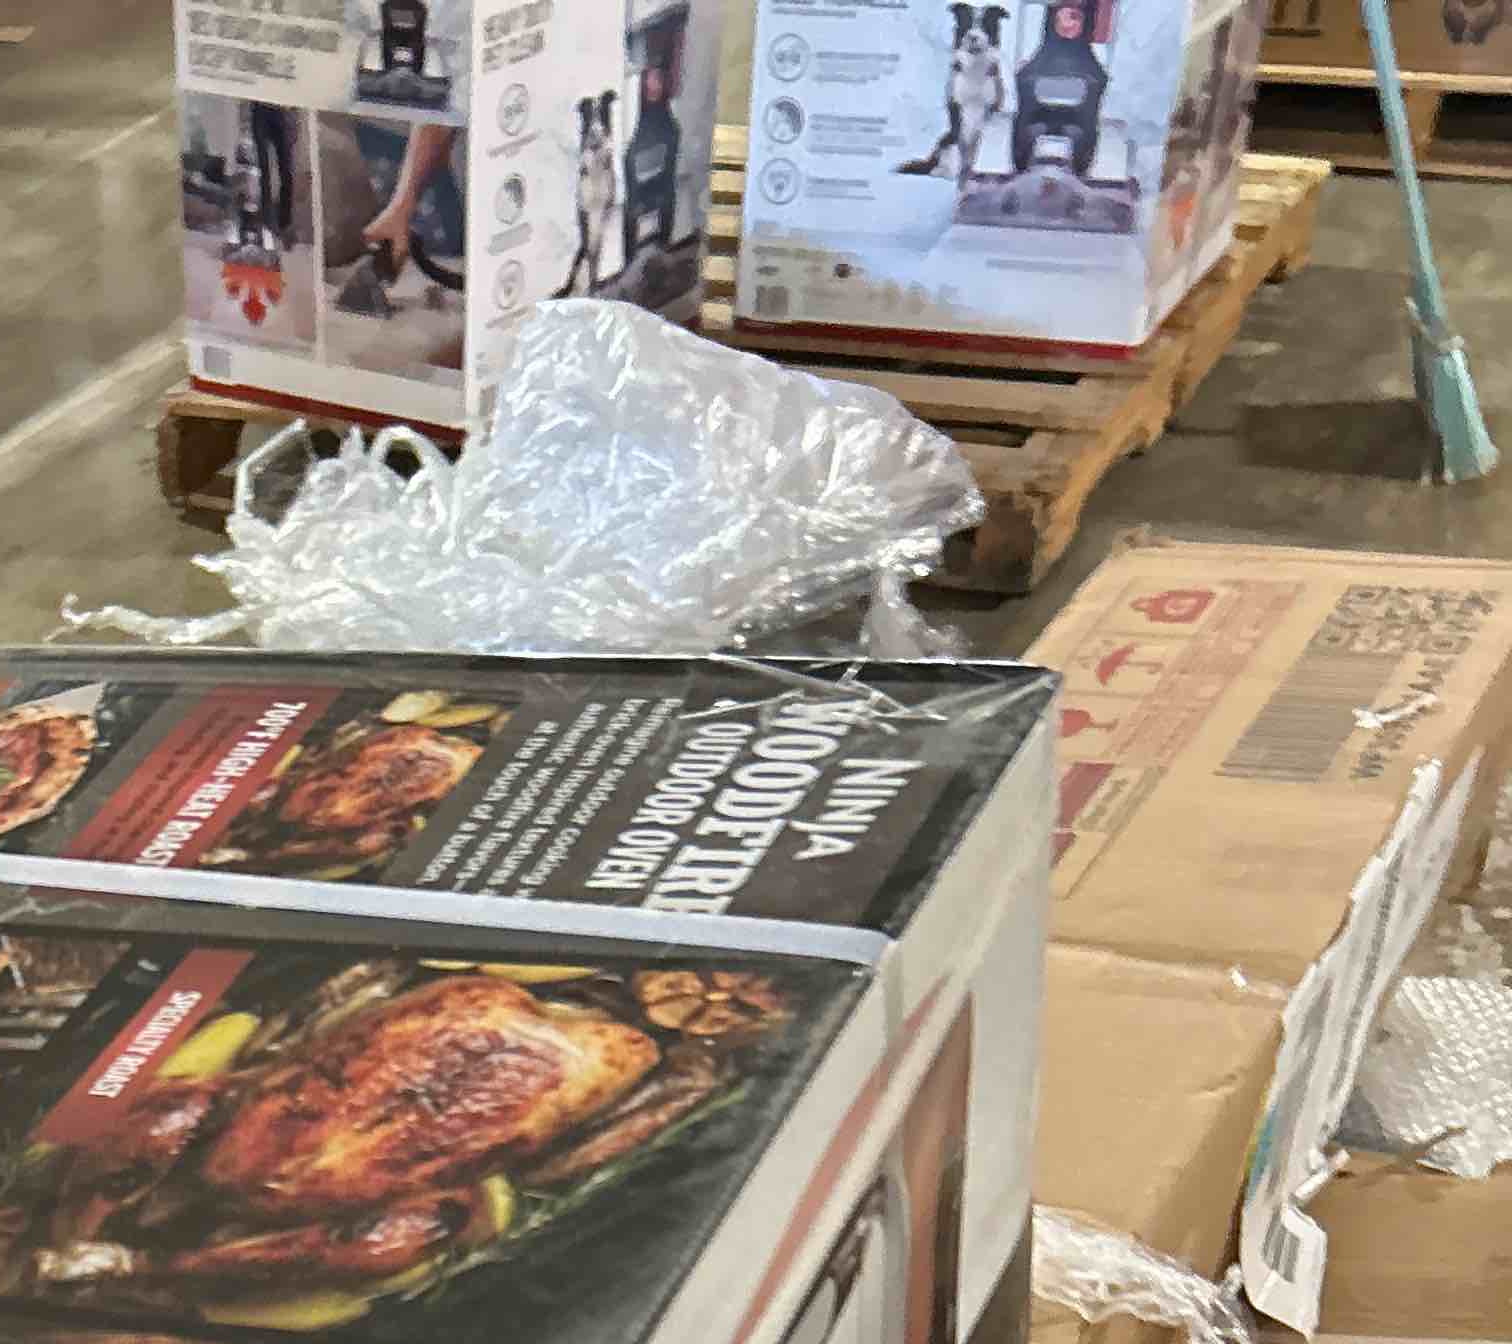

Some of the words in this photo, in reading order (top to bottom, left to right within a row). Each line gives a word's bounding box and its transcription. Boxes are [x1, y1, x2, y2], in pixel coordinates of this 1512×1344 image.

[514, 737, 550, 758] the
[542, 703, 610, 763] authentic
[606, 698, 685, 765] Reimagine
[171, 741, 275, 818] HIGH-HEAT
[480, 762, 531, 801] touch
[493, 767, 560, 828] woodfire
[566, 768, 630, 824] outdoor
[627, 722, 759, 826] OUTDOOR
[466, 803, 500, 819] of
[789, 758, 928, 861] NINJA
[484, 827, 550, 885] textures
[516, 827, 587, 884] cooking
[582, 828, 685, 890] OVEN
[120, 989, 206, 1055] SPECIALTY
[85, 1056, 149, 1098] ROAST
